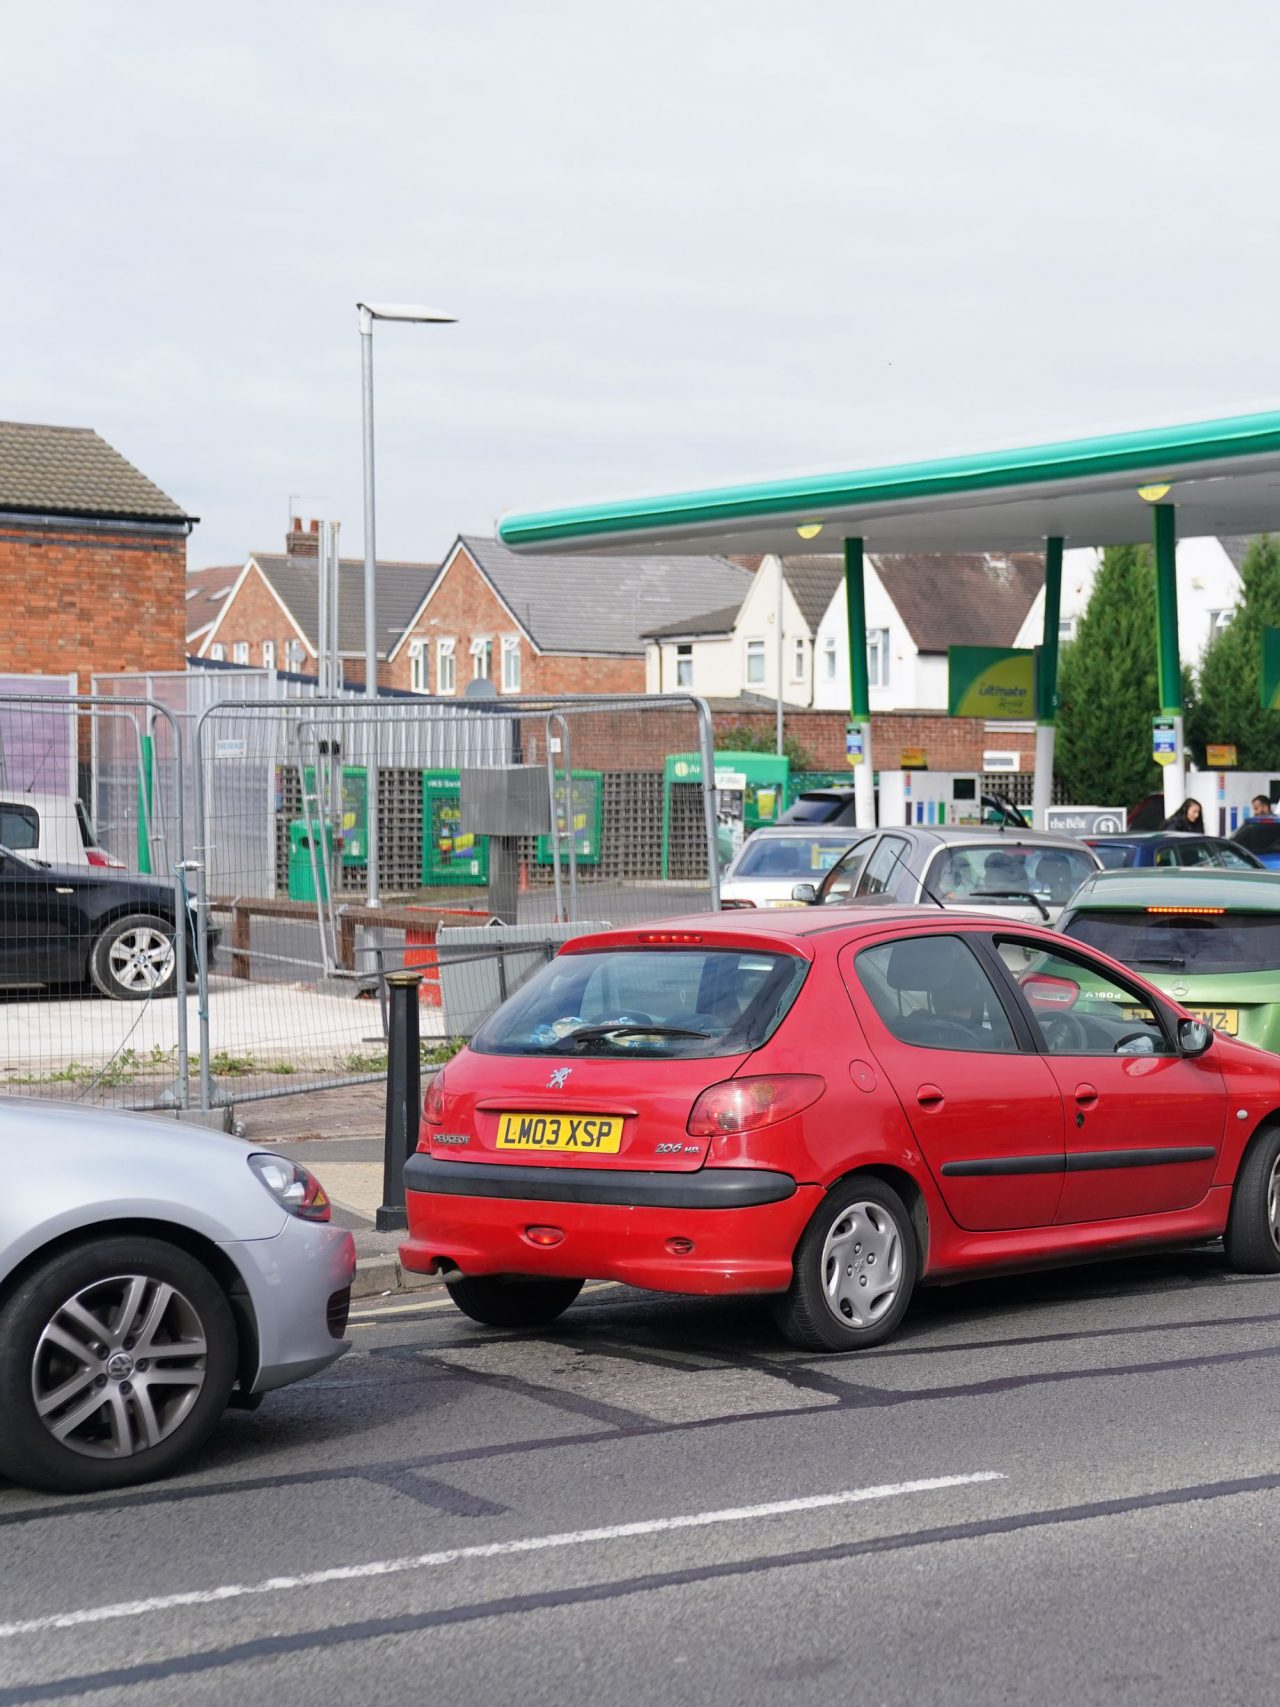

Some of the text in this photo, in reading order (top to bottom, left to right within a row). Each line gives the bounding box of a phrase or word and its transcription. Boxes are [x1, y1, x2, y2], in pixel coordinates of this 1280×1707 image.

[979, 685, 1027, 698] ultimate
[1050, 816, 1087, 829] the Best
[1100, 820, 1114, 833] £1
[433, 1133, 471, 1145] PEUGEOT
[503, 1117, 613, 1148] LM03 XSP
[655, 1142, 683, 1153] 206
